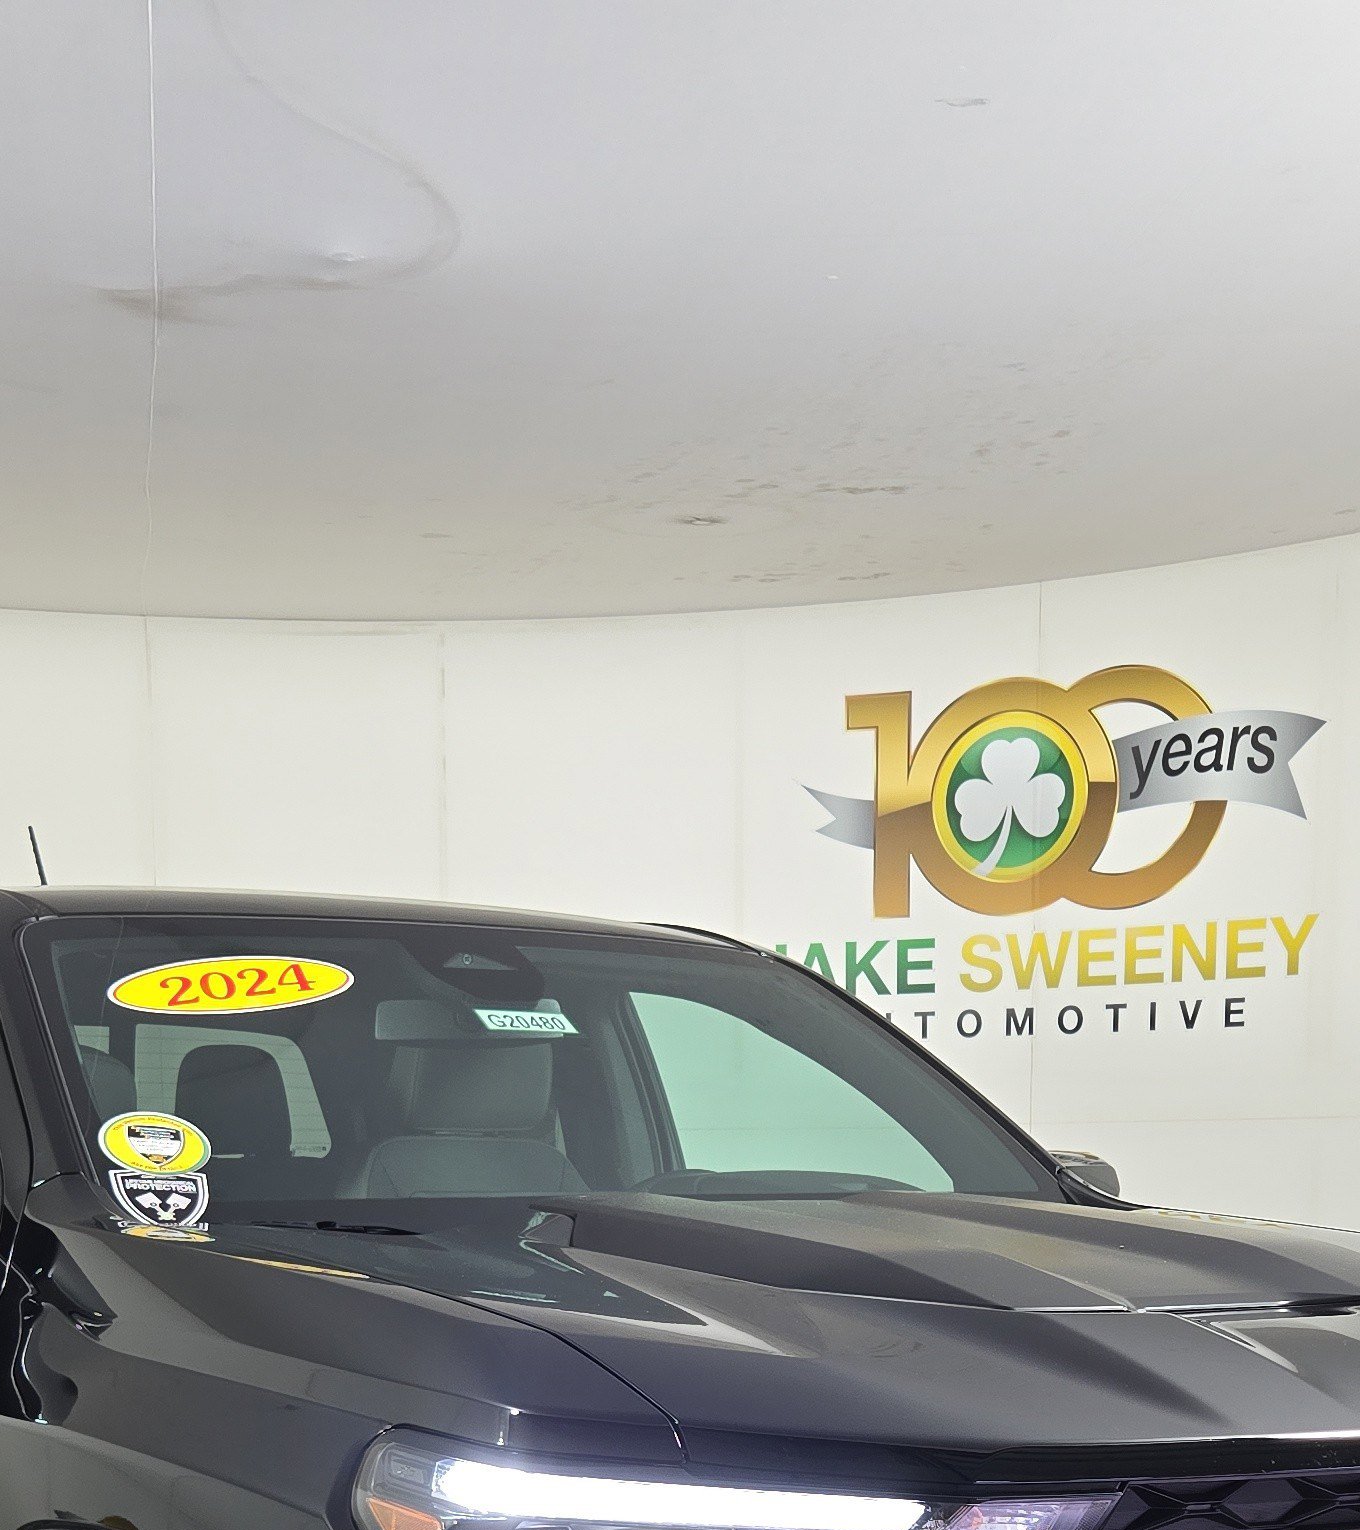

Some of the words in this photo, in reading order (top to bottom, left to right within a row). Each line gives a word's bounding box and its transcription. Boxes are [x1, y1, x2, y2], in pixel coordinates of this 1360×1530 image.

[1129, 722, 1278, 799] years
[959, 913, 1320, 993] SWEENEY
[160, 963, 317, 1007] 2024
[488, 1014, 566, 1030] G20480
[886, 997, 1247, 1040] TOMOTIVE
